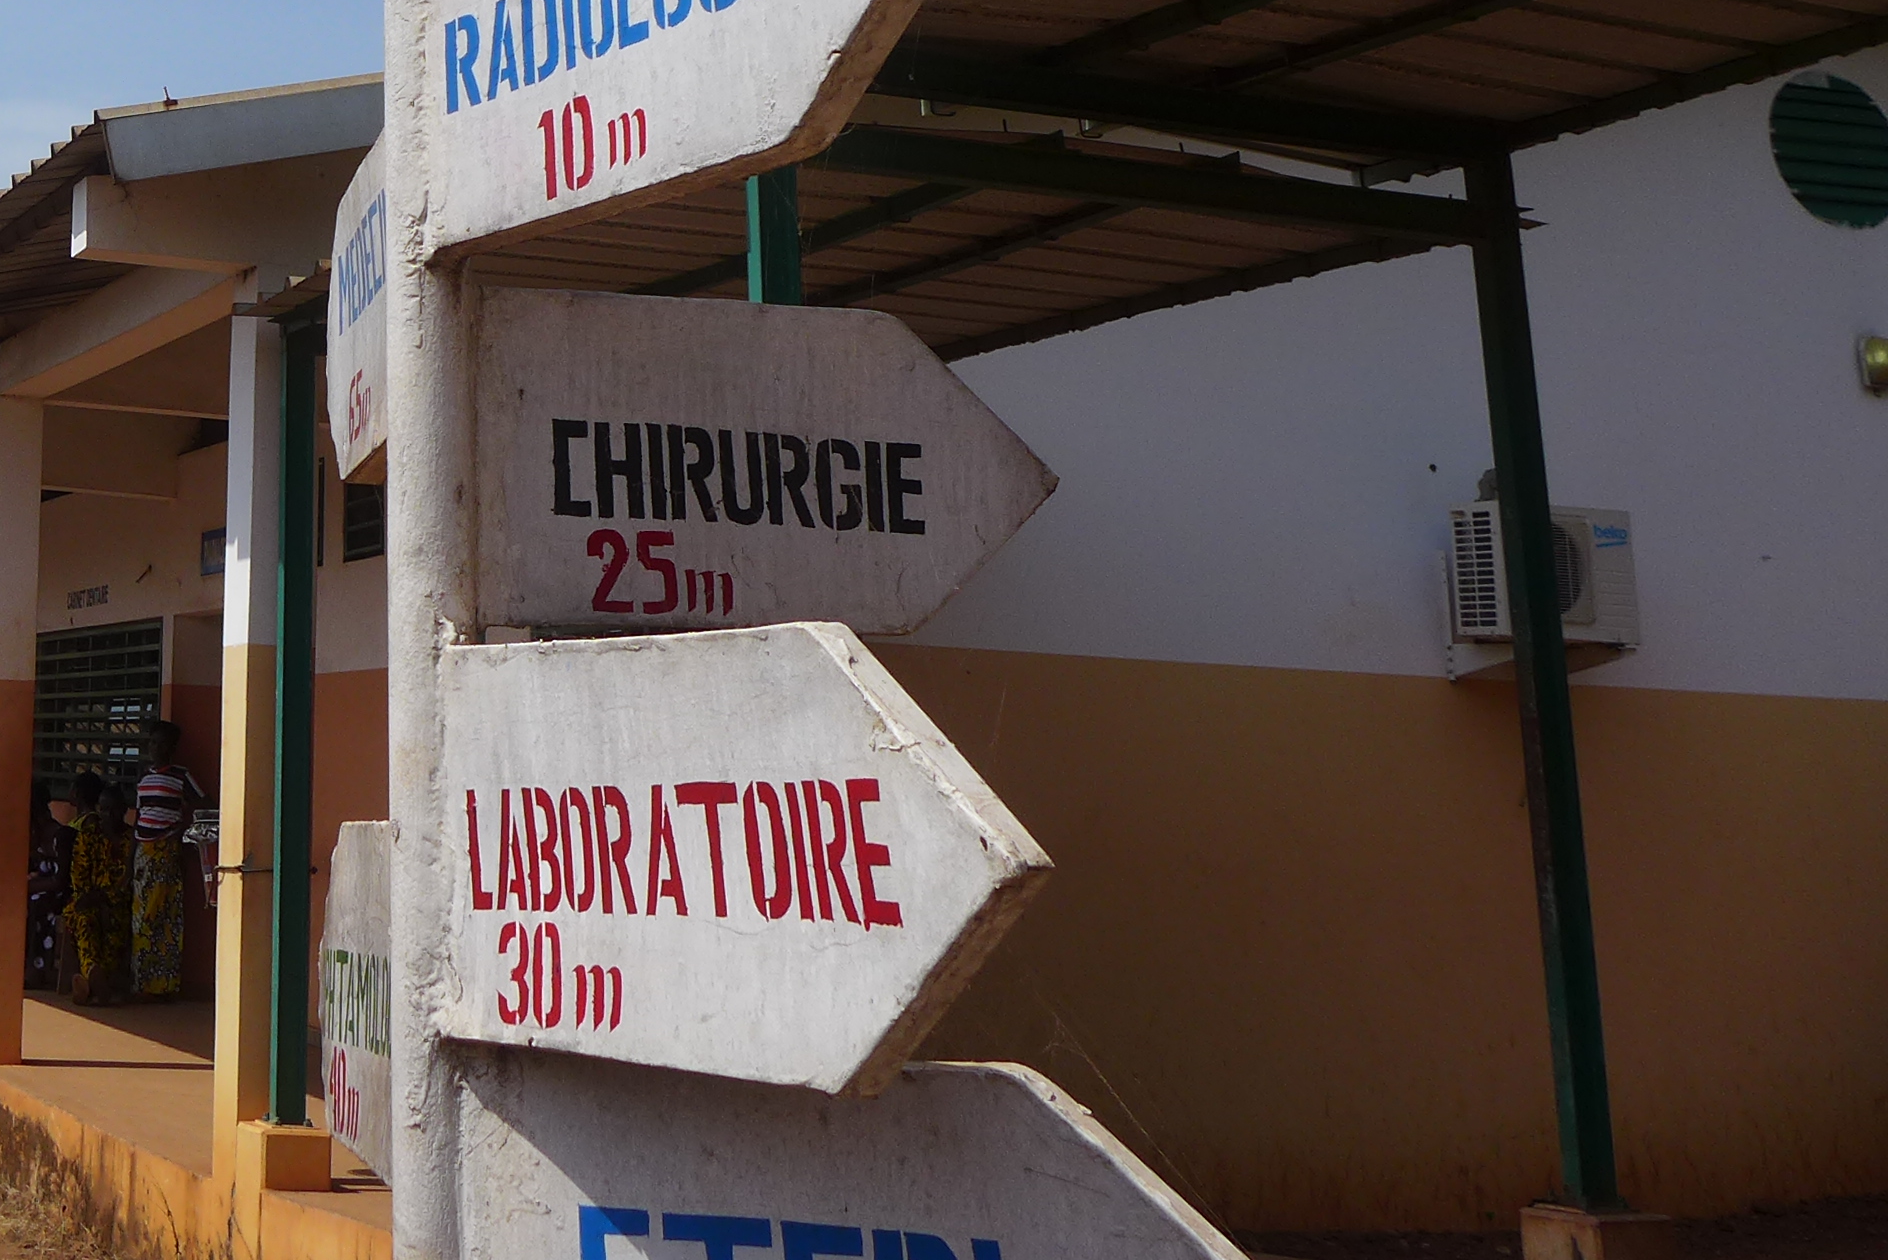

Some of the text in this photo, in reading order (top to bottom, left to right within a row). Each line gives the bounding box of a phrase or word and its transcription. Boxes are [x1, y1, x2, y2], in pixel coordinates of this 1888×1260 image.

[537, 95, 593, 201] 10
[551, 418, 925, 535] CHIRURGIE
[465, 776, 903, 931] LABORATOIRE
[496, 921, 561, 1029] 30
